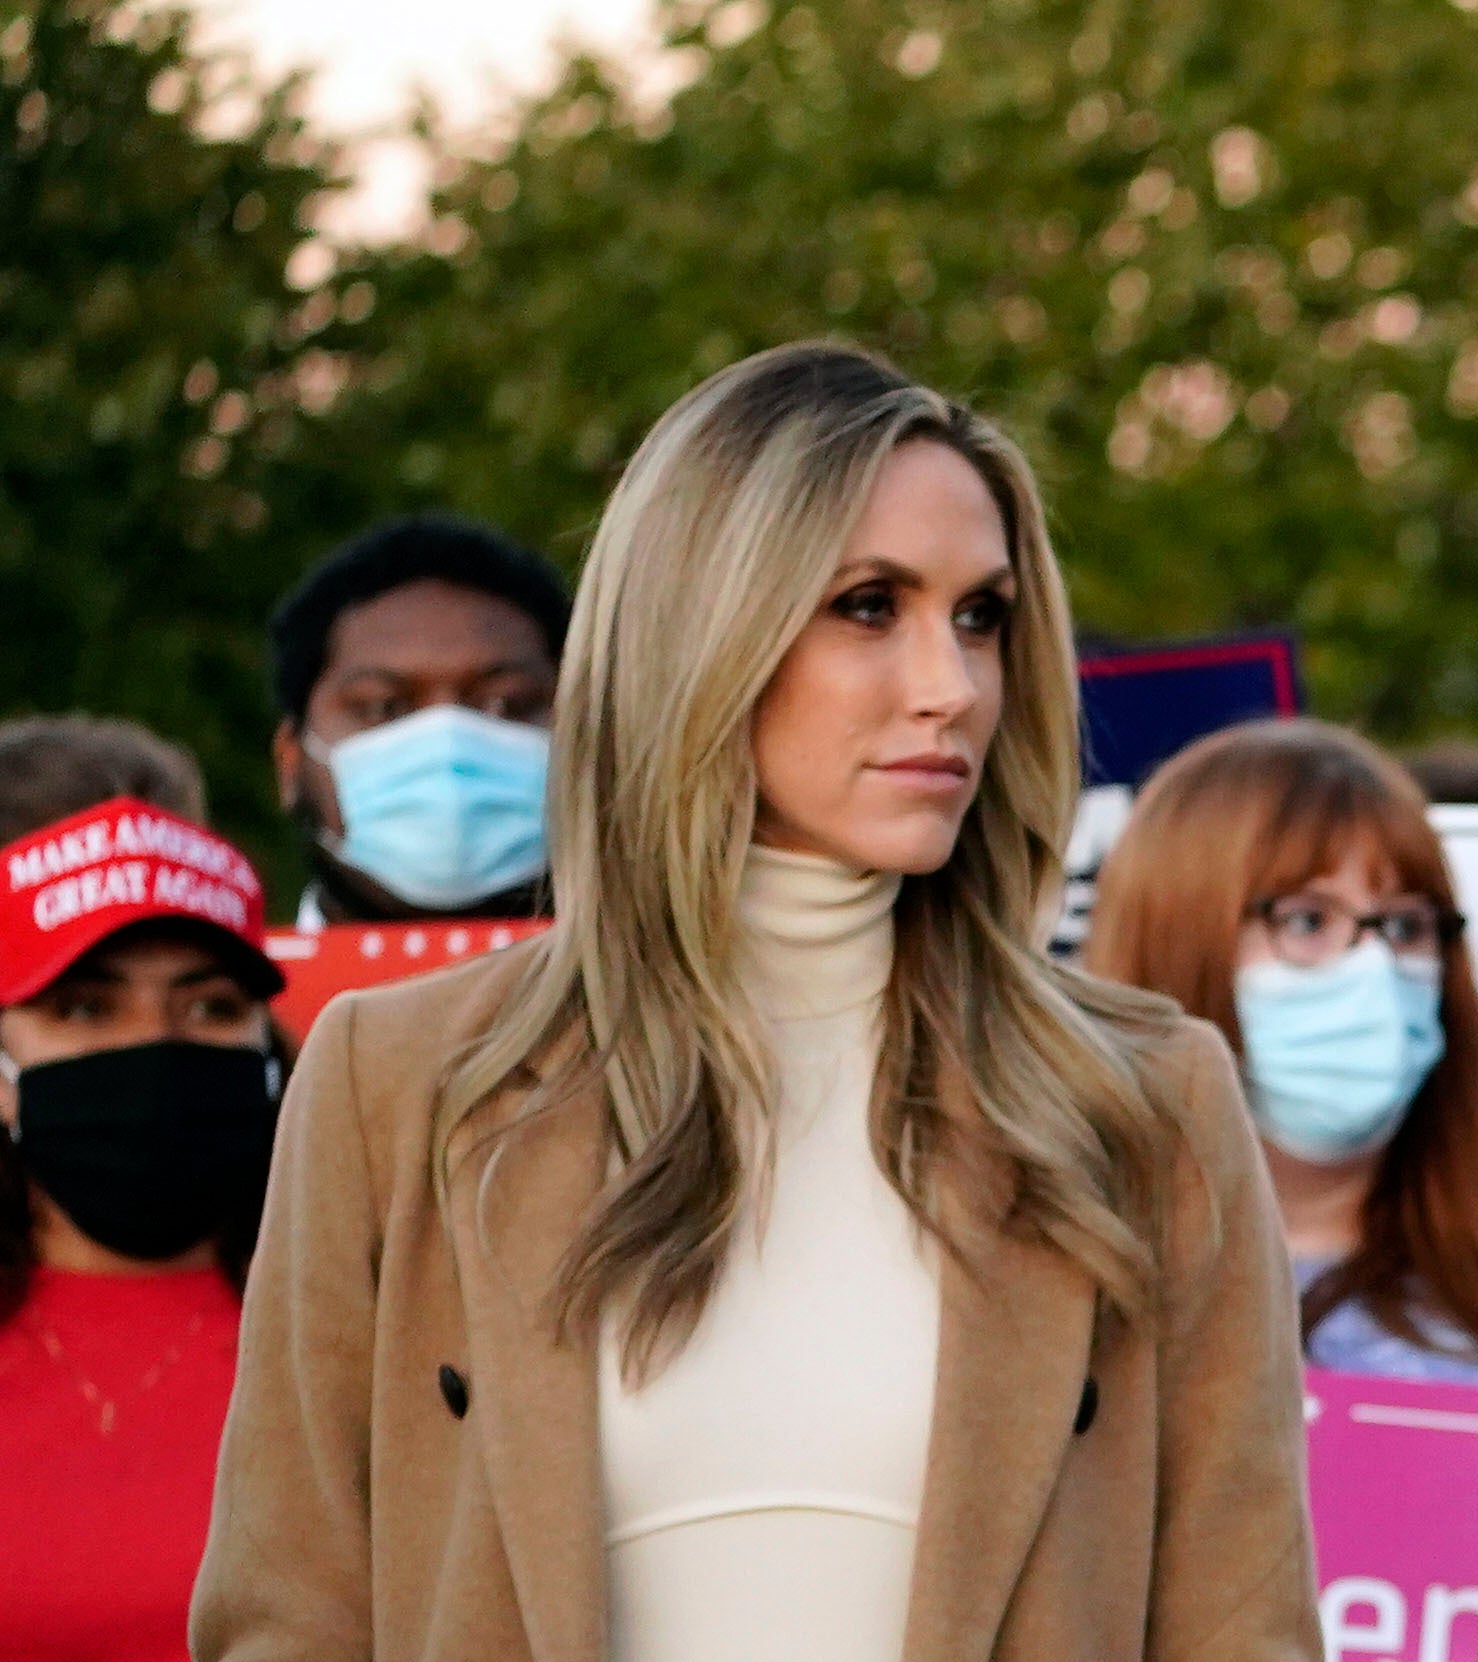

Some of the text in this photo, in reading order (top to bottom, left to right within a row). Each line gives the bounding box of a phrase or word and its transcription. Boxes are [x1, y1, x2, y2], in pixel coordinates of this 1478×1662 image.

[9, 814, 261, 898] MAKE AMERICA
[34, 859, 249, 932] GREAT AGAIN
